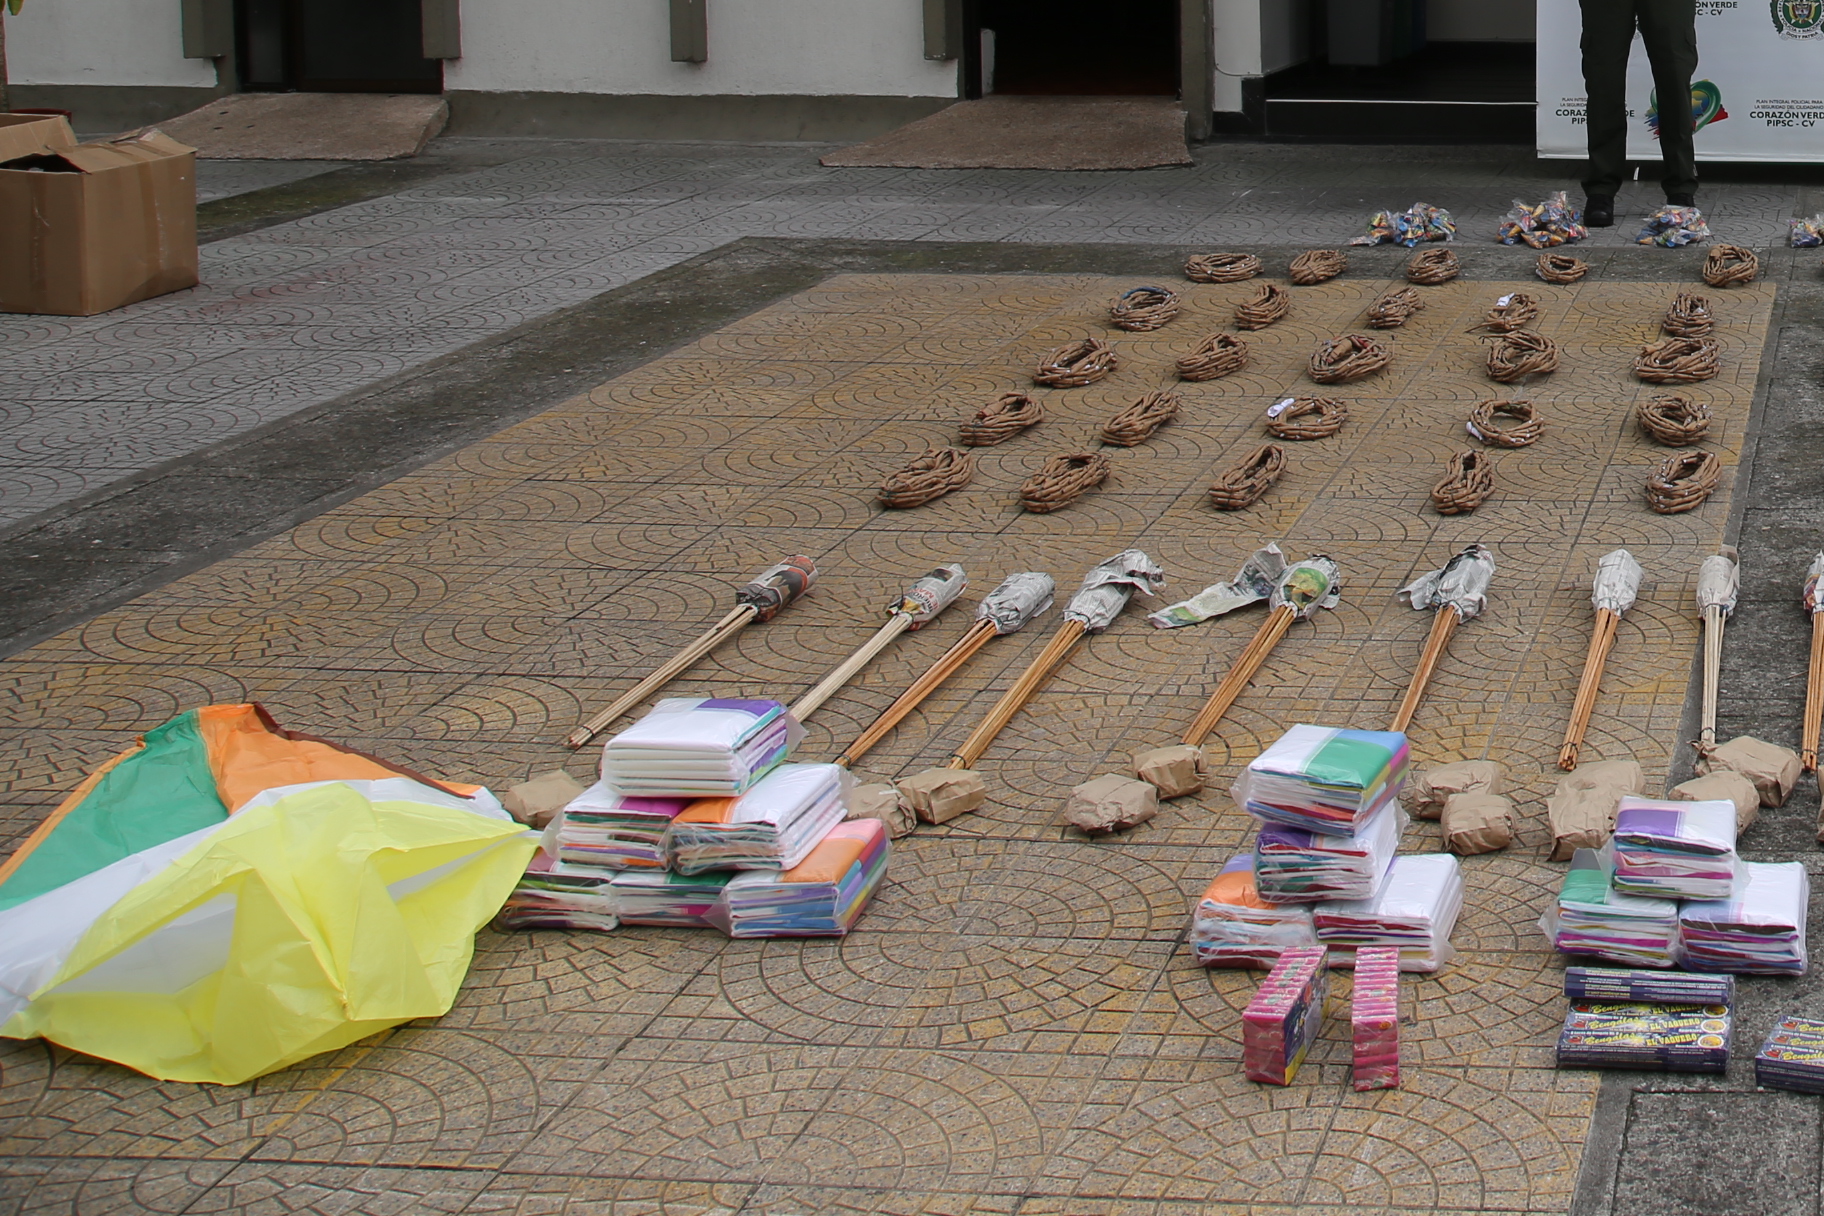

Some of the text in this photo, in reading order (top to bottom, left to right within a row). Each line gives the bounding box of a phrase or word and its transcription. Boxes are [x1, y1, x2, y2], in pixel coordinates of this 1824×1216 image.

[1649, 1018, 1701, 1031] EL VAQUERO
[1646, 1033, 1698, 1046] EL VAQUERO
